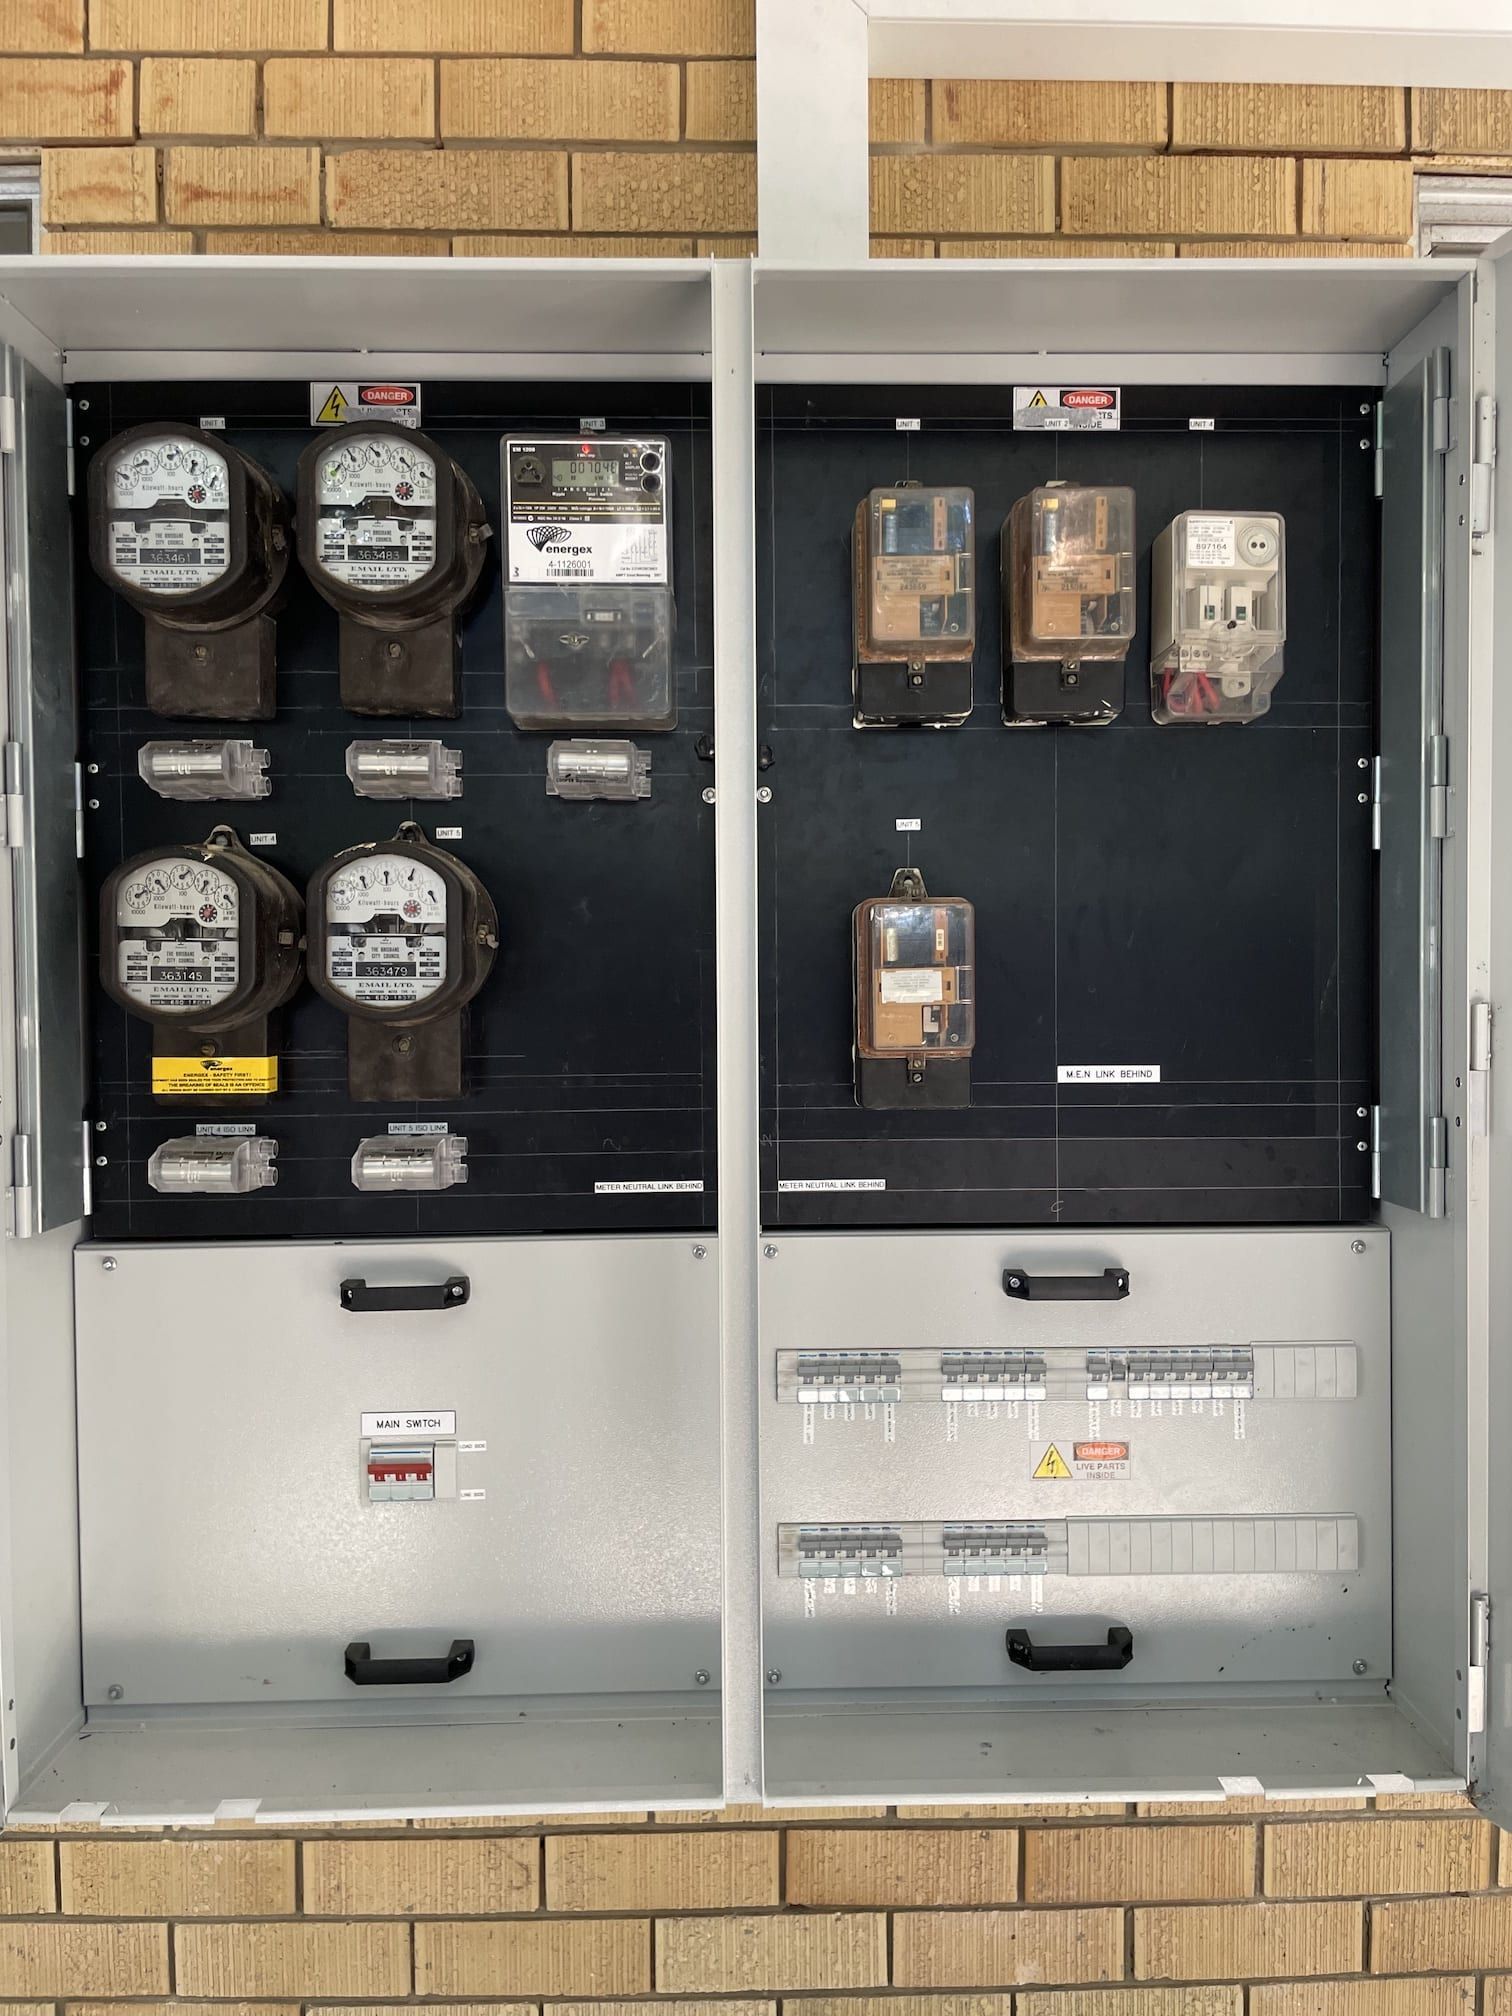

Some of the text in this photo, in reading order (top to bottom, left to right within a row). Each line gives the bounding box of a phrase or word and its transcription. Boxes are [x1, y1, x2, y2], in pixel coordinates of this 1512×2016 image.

[368, 392, 408, 400] DANGER
[1068, 396, 1108, 404] DANGER
[358, 551, 400, 560] 363483
[546, 546, 592, 556] energex
[365, 966, 408, 976] 363479
[160, 972, 202, 980] 363145
[376, 1419, 440, 1428] MAIN SWITCH
